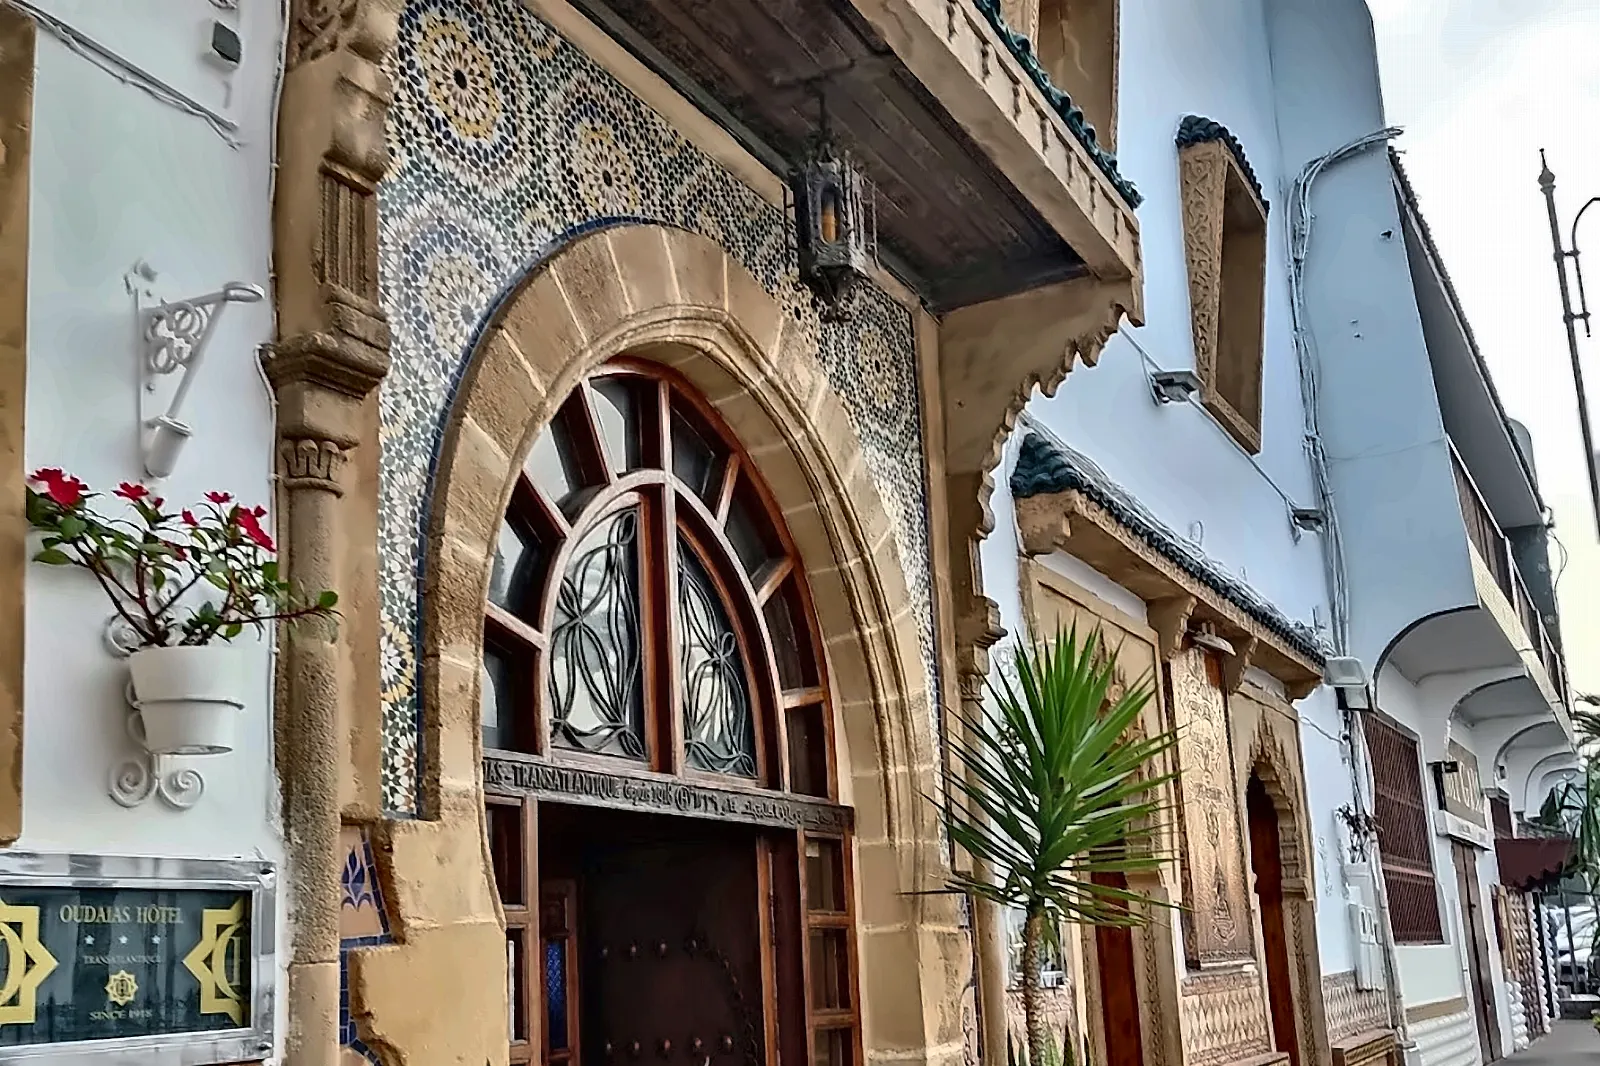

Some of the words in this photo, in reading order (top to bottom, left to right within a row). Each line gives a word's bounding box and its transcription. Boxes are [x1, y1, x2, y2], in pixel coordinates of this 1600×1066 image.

[59, 904, 131, 923] OUDAIAS
[135, 904, 184, 924] HÔTEL
[89, 1010, 127, 1021] SINCE
